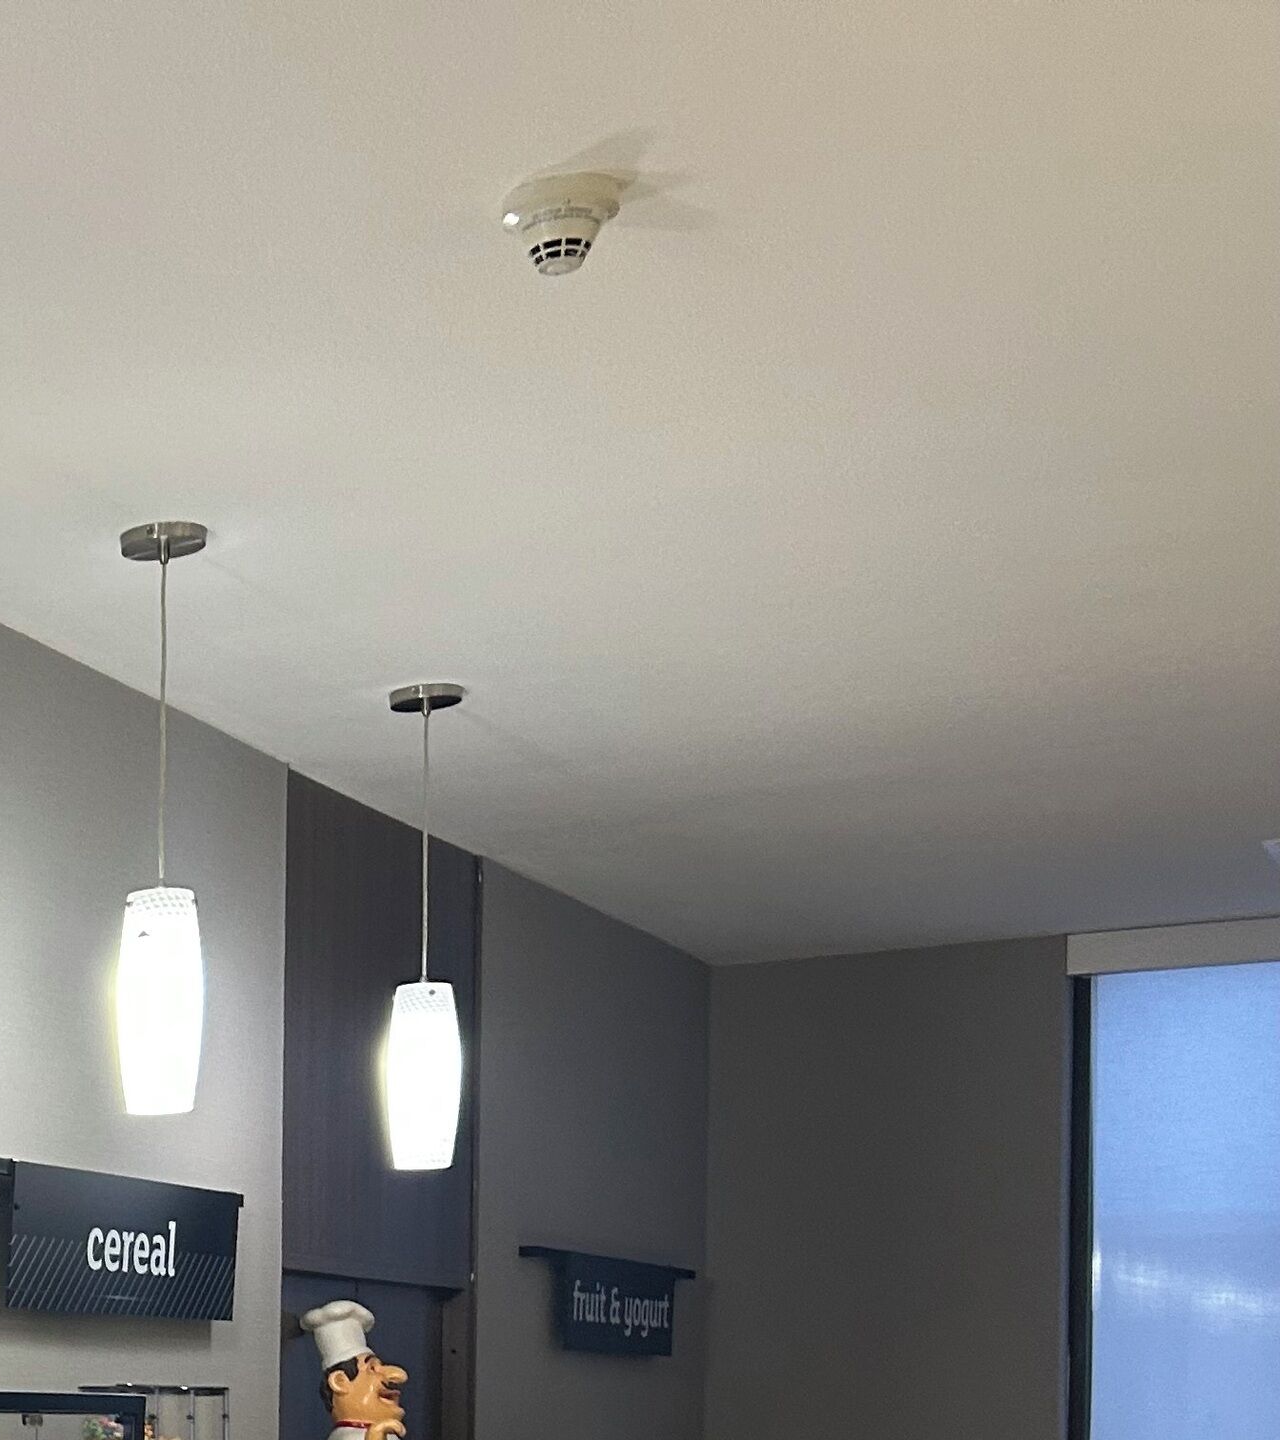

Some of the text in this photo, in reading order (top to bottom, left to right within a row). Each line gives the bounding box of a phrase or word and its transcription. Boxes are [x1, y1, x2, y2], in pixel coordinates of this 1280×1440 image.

[86, 1220, 178, 1279] cereal
[573, 1279, 670, 1338] fruit & yogurt
